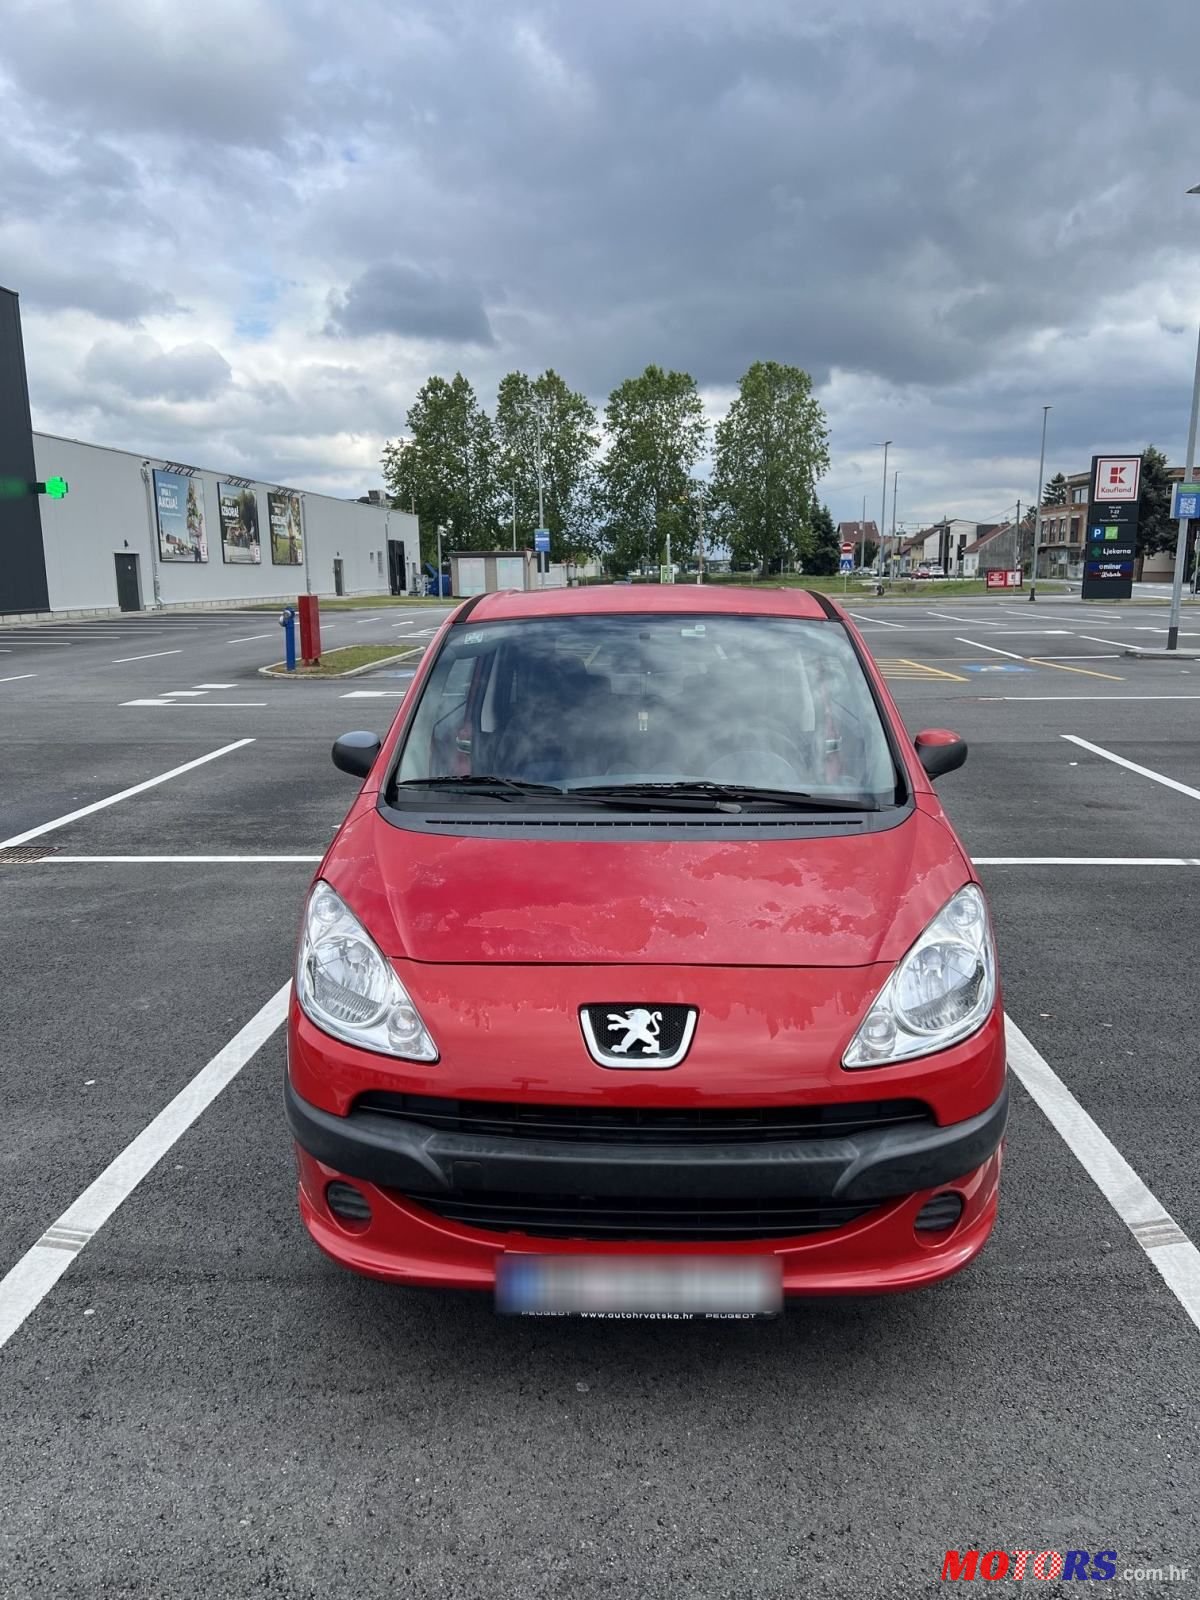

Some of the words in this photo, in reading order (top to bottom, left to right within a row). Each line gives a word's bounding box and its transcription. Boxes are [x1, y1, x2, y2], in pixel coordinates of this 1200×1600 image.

[1094, 528, 1101, 537] P
[580, 1311, 694, 1321] www.autohrvatska.hr
[705, 1312, 757, 1320] PEUGEOT
